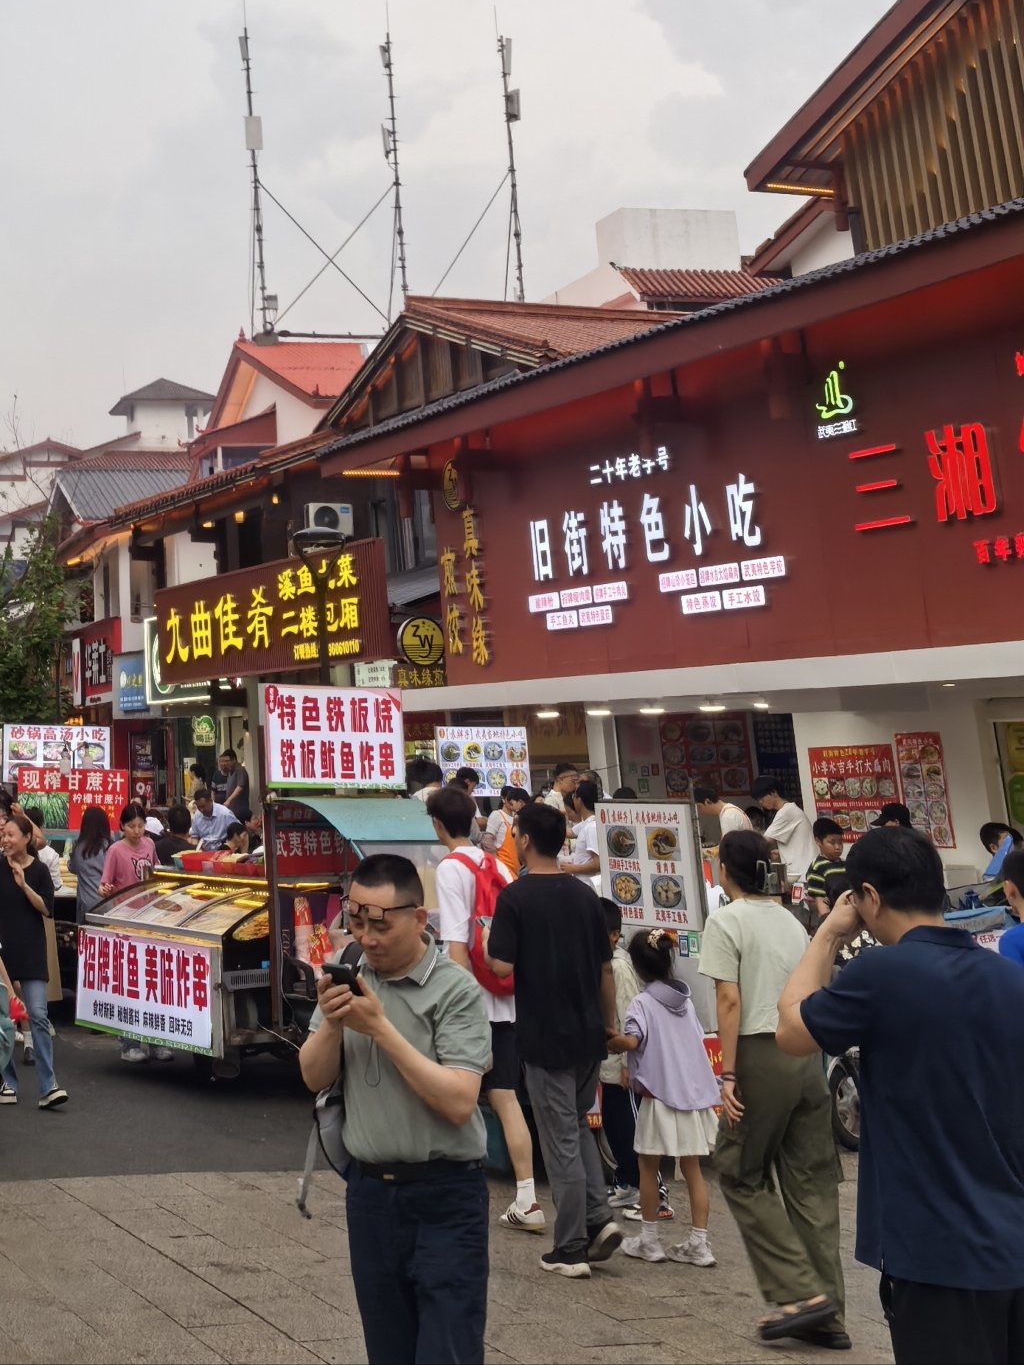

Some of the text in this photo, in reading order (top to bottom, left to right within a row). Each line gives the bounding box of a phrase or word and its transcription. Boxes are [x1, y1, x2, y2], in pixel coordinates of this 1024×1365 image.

[849, 422, 1024, 531] 三湘
[530, 473, 761, 581] 旧街特色小吃
[686, 595, 717, 611] 特色蒸饺
[728, 590, 761, 606] 手工水饺
[166, 586, 273, 663] 九曲佳肴
[277, 695, 393, 733] 特色铁板烧
[11, 726, 107, 741] 砂锅高汤小吃
[280, 739, 395, 779] 铁板鱿鱼炸串
[23, 770, 124, 792] 现榨甘蔗汁
[73, 794, 124, 804] 柠檬甘蔗汁
[83, 934, 208, 1011] 招牌鱿鱼 美味炸串
[93, 1000, 114, 1021] 食材新鲜
[142, 1011, 166, 1032] 麻辣鲜香
[169, 1016, 193, 1037] 回味无穷
